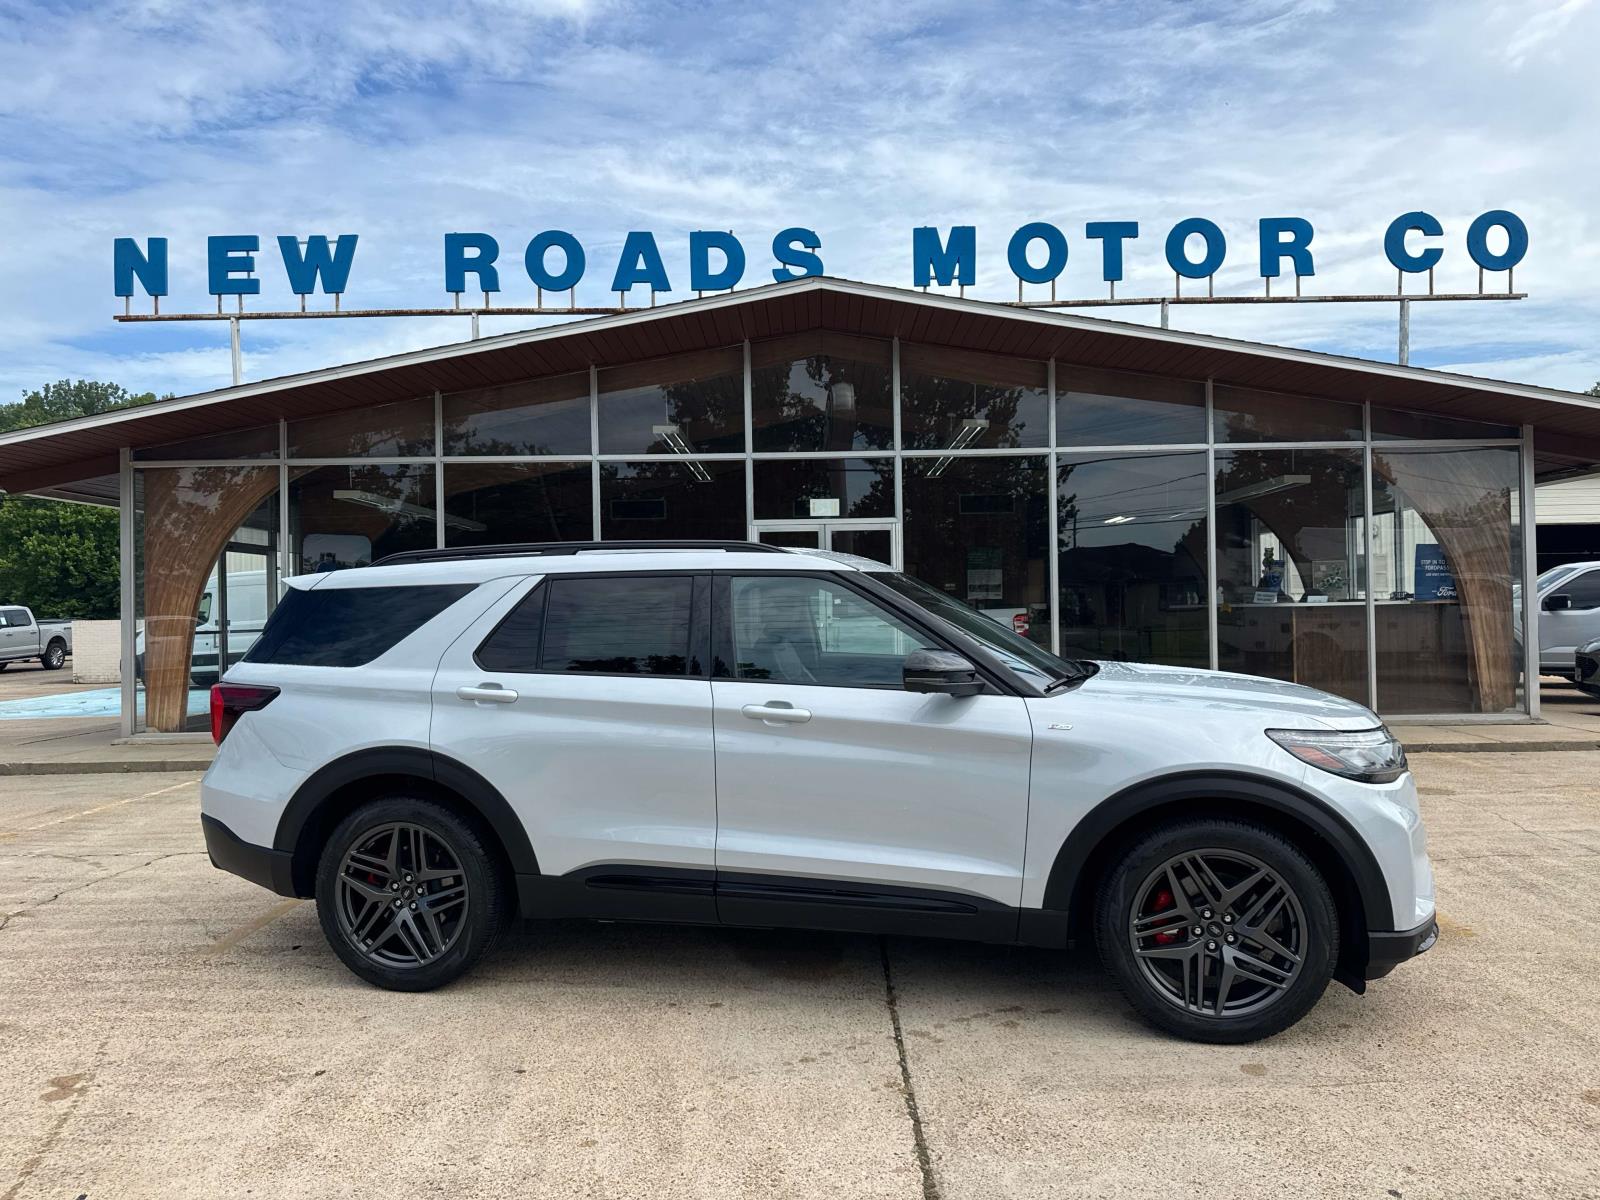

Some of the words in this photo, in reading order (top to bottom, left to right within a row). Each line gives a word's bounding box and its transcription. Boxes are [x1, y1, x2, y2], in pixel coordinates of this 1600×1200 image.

[113, 234, 359, 297] NEW
[444, 227, 824, 294] ROADS
[912, 217, 1315, 288] MOTOR
[1384, 210, 1529, 273] CO
